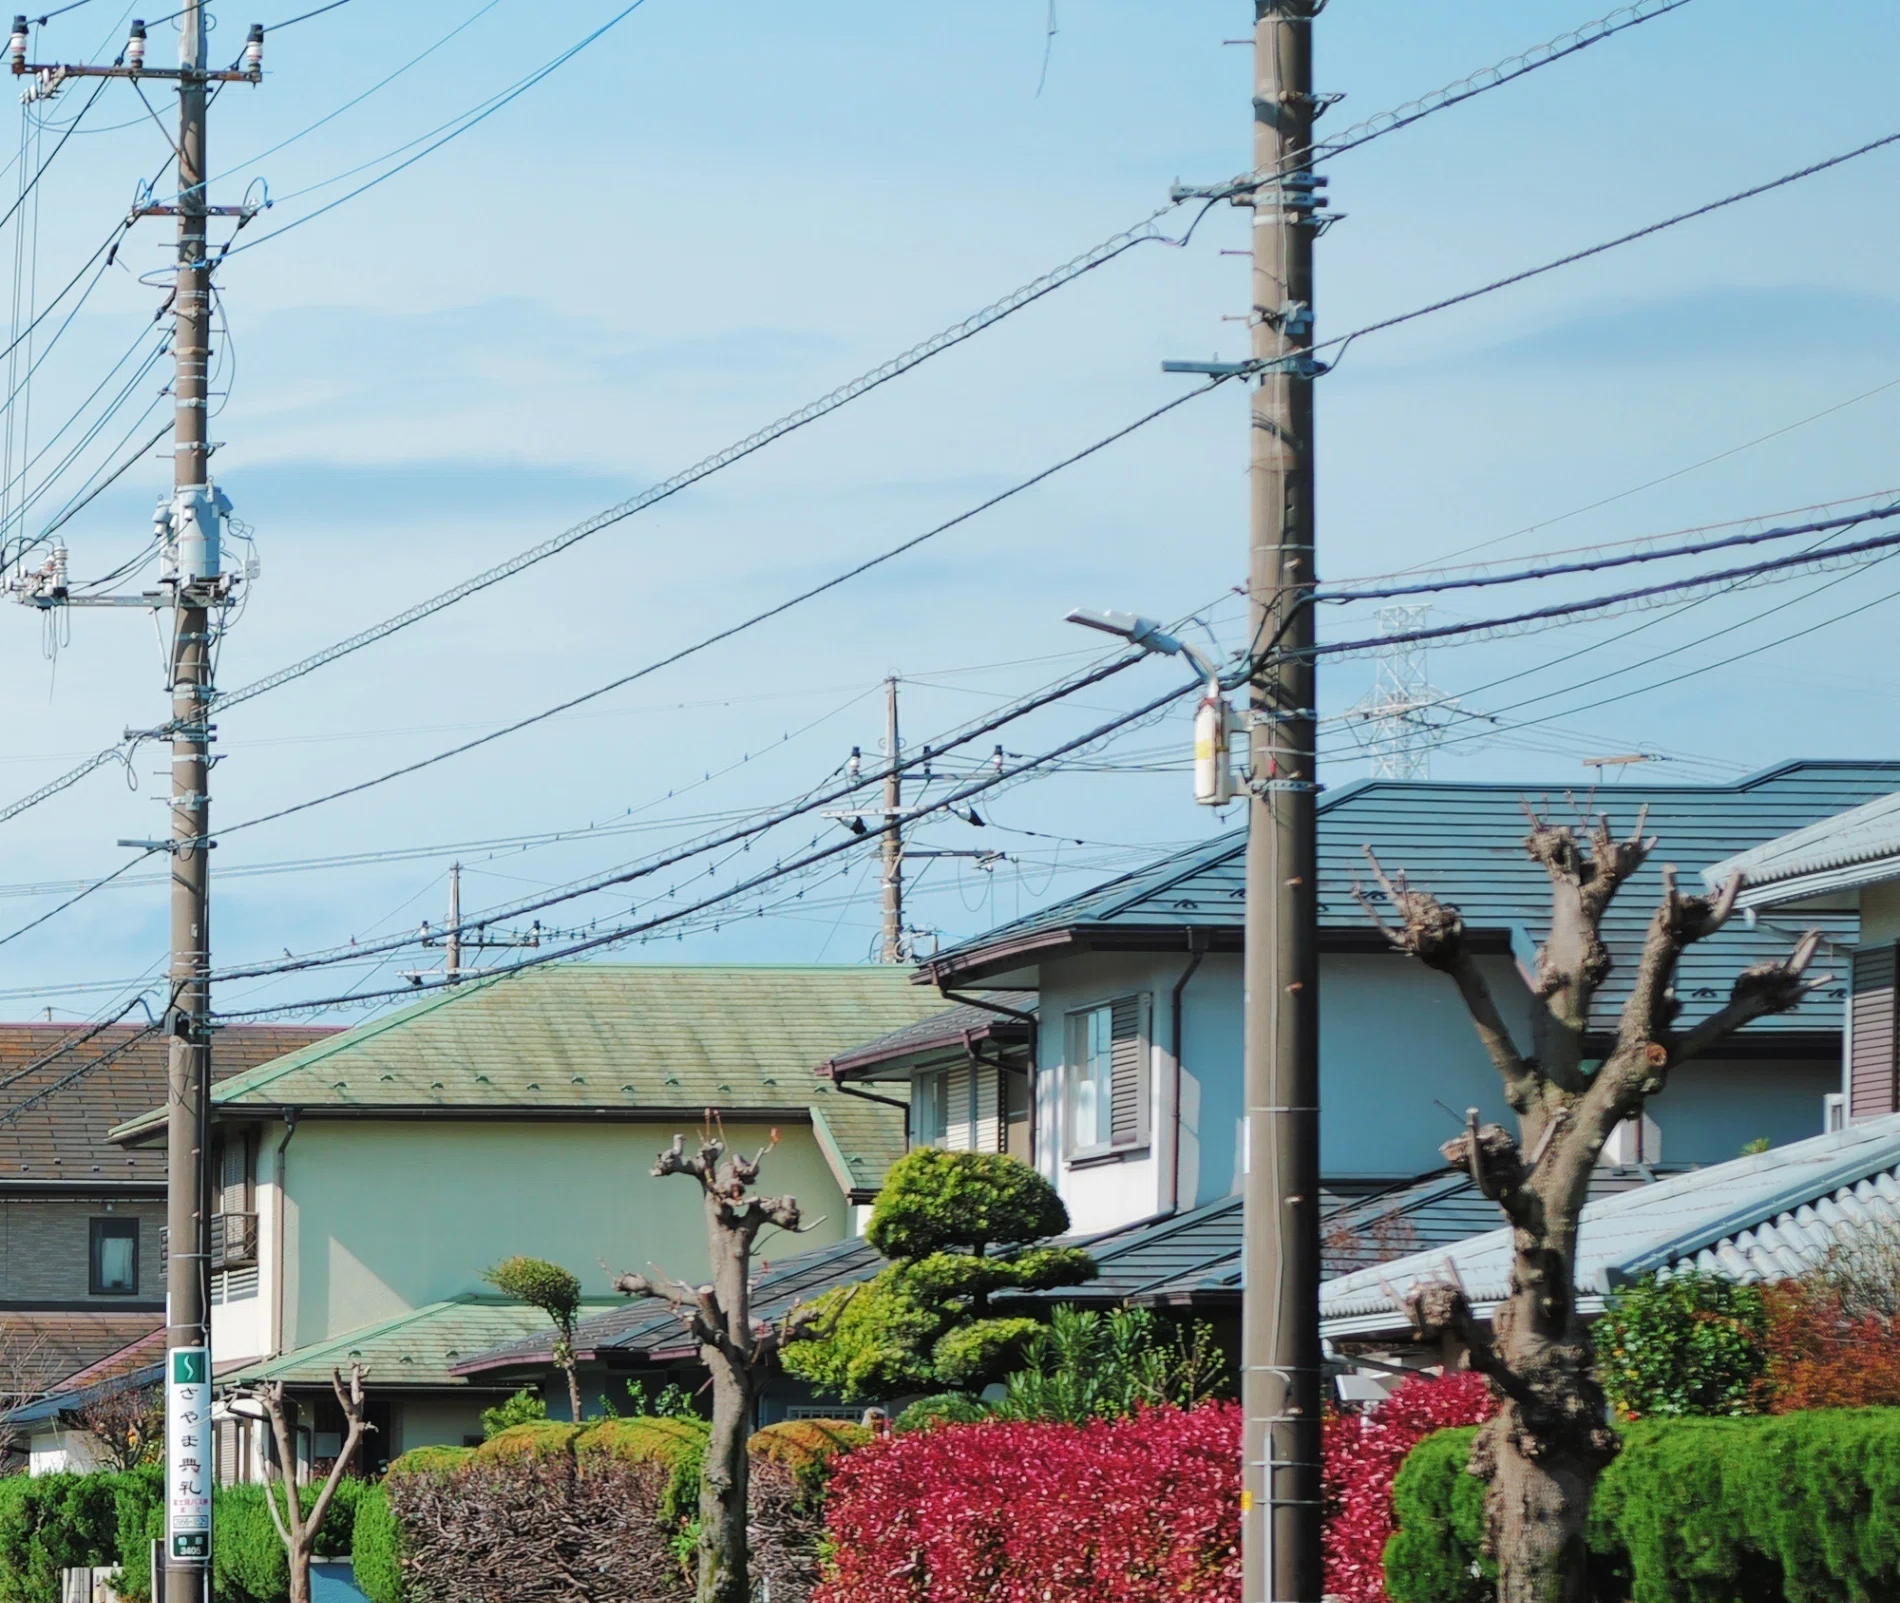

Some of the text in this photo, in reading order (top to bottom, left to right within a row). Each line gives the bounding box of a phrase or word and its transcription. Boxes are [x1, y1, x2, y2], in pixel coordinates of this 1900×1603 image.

[177, 1387, 202, 1496] さやま典礼
